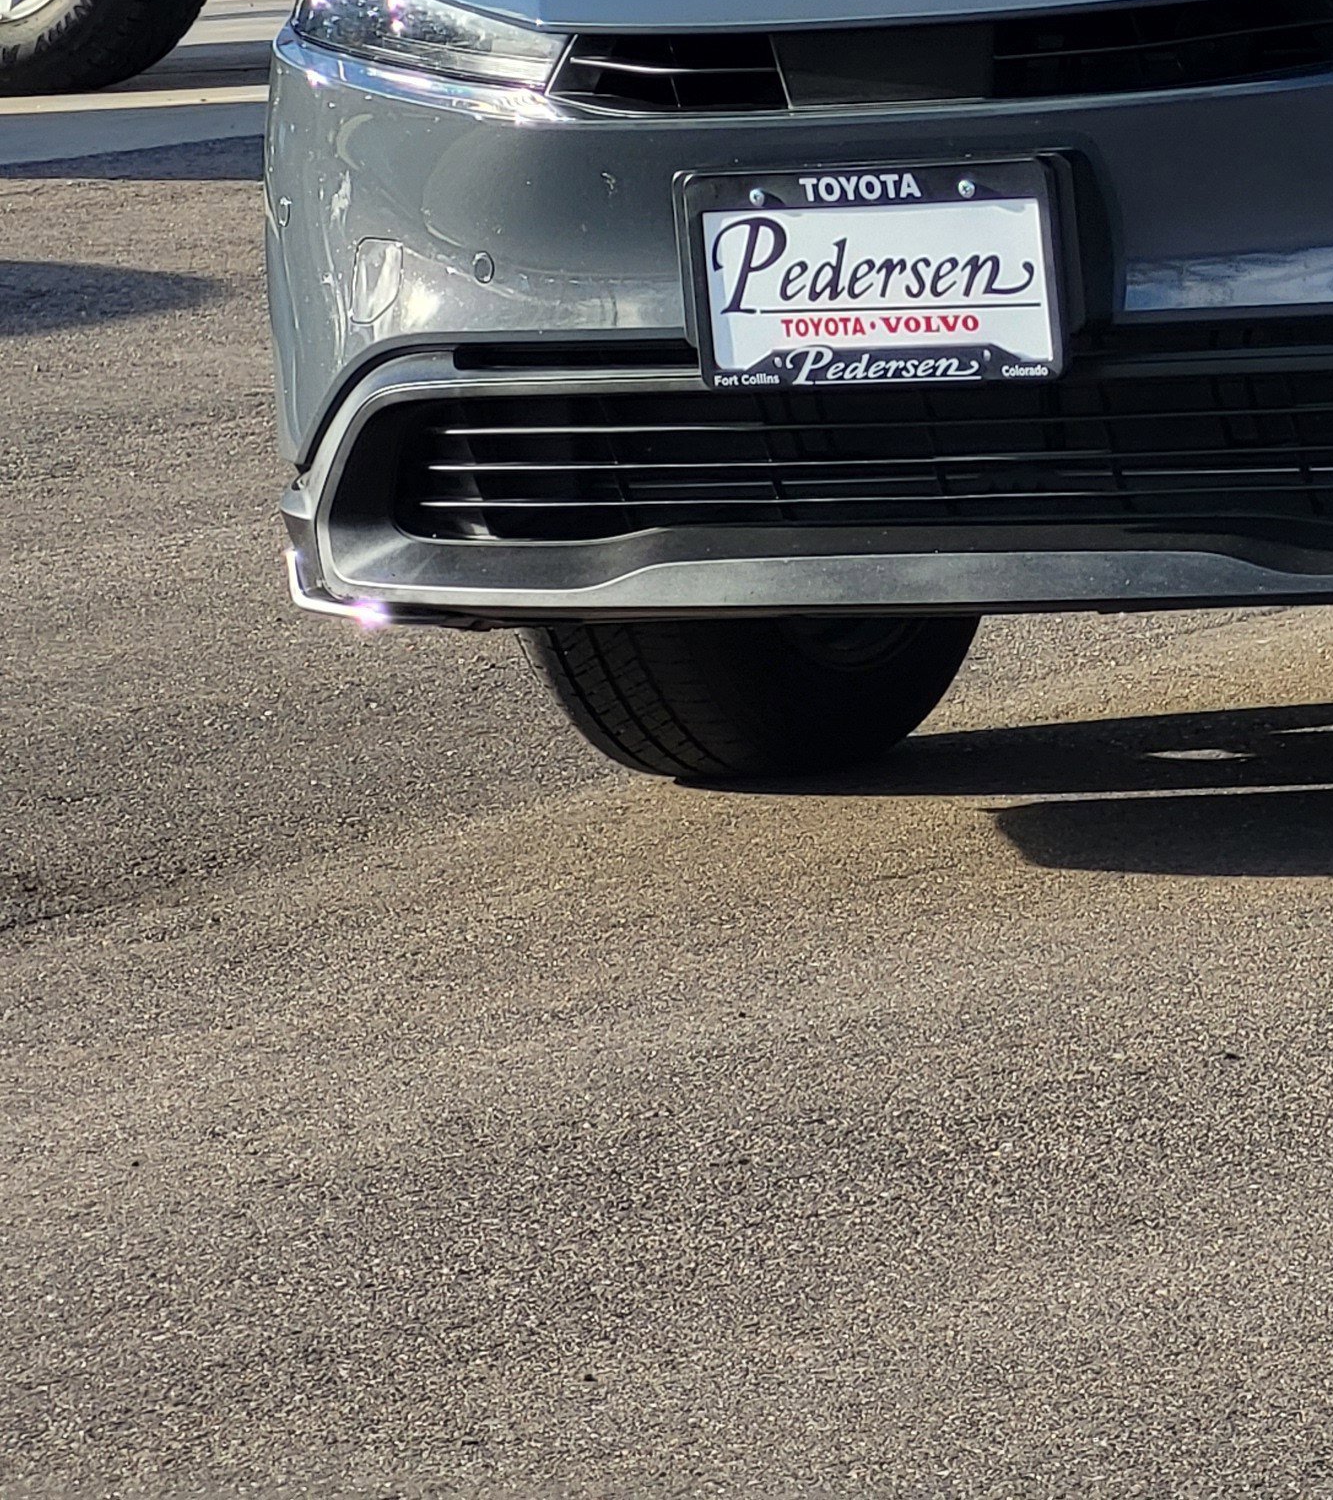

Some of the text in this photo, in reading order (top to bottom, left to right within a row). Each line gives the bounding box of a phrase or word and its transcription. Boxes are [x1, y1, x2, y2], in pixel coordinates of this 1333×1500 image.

[799, 174, 921, 201] TOYOTA
[713, 217, 1034, 314] Pedersen
[780, 314, 979, 338] TOYOTA VOLVO
[786, 346, 979, 385] Pedersen
[1001, 365, 1048, 377] Colorado
[714, 373, 780, 386] Fort Collins
